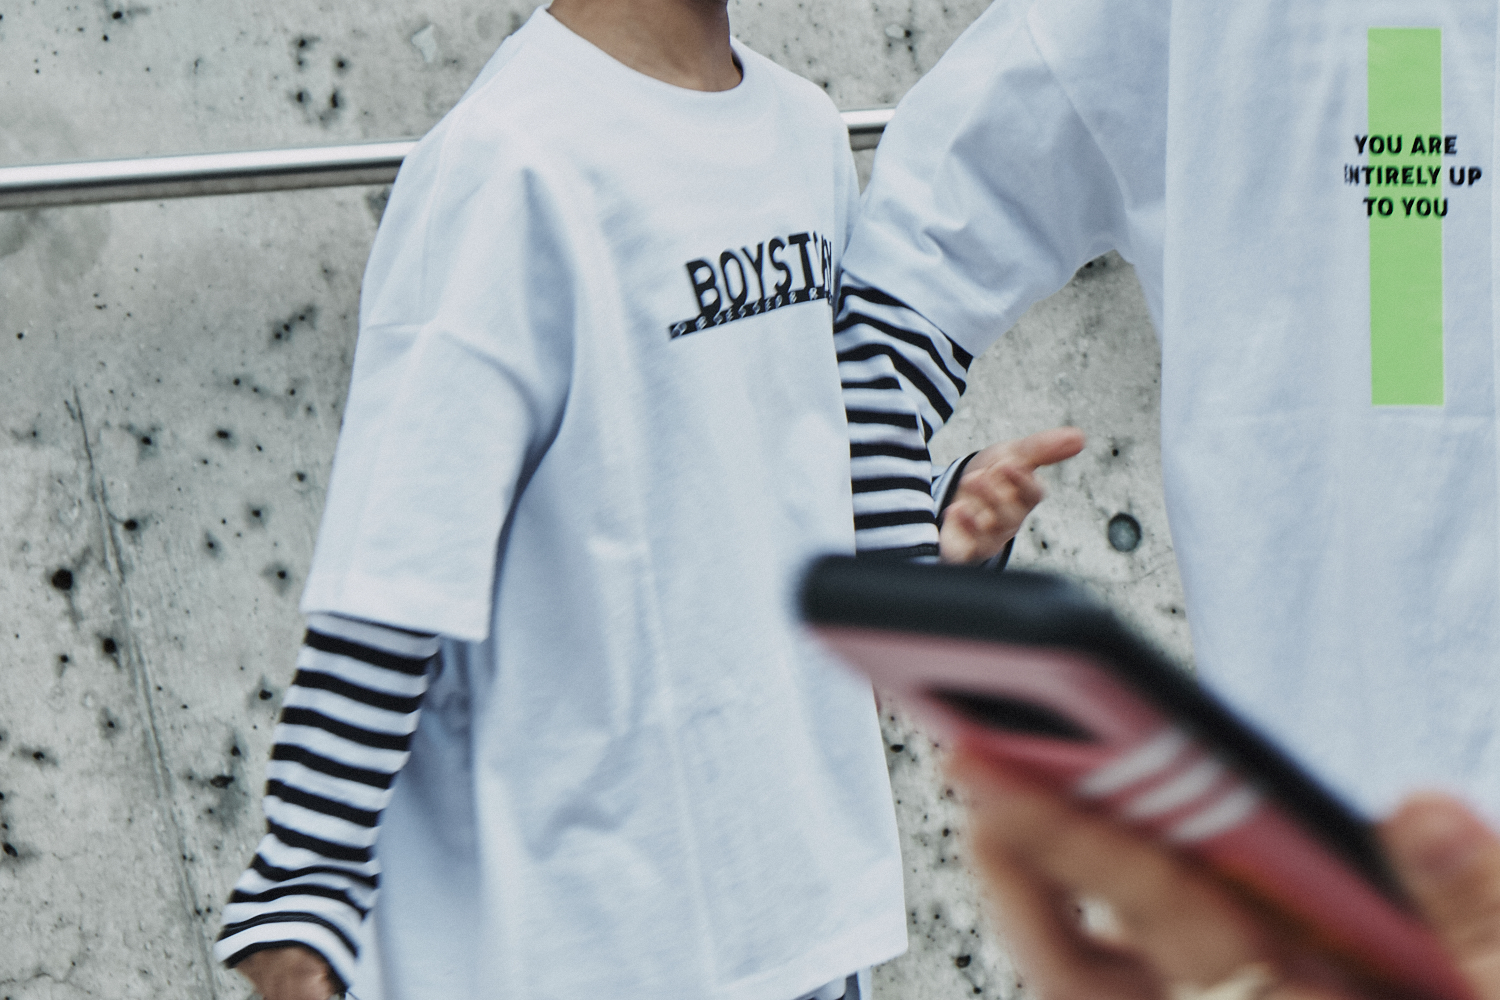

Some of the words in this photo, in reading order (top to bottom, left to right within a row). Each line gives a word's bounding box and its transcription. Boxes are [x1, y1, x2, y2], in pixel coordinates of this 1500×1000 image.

[1354, 134, 1403, 155] YOU
[1410, 134, 1458, 155] ARE
[1449, 166, 1483, 187] UP
[1363, 197, 1394, 218] TO
[1402, 197, 1449, 219] YOU
